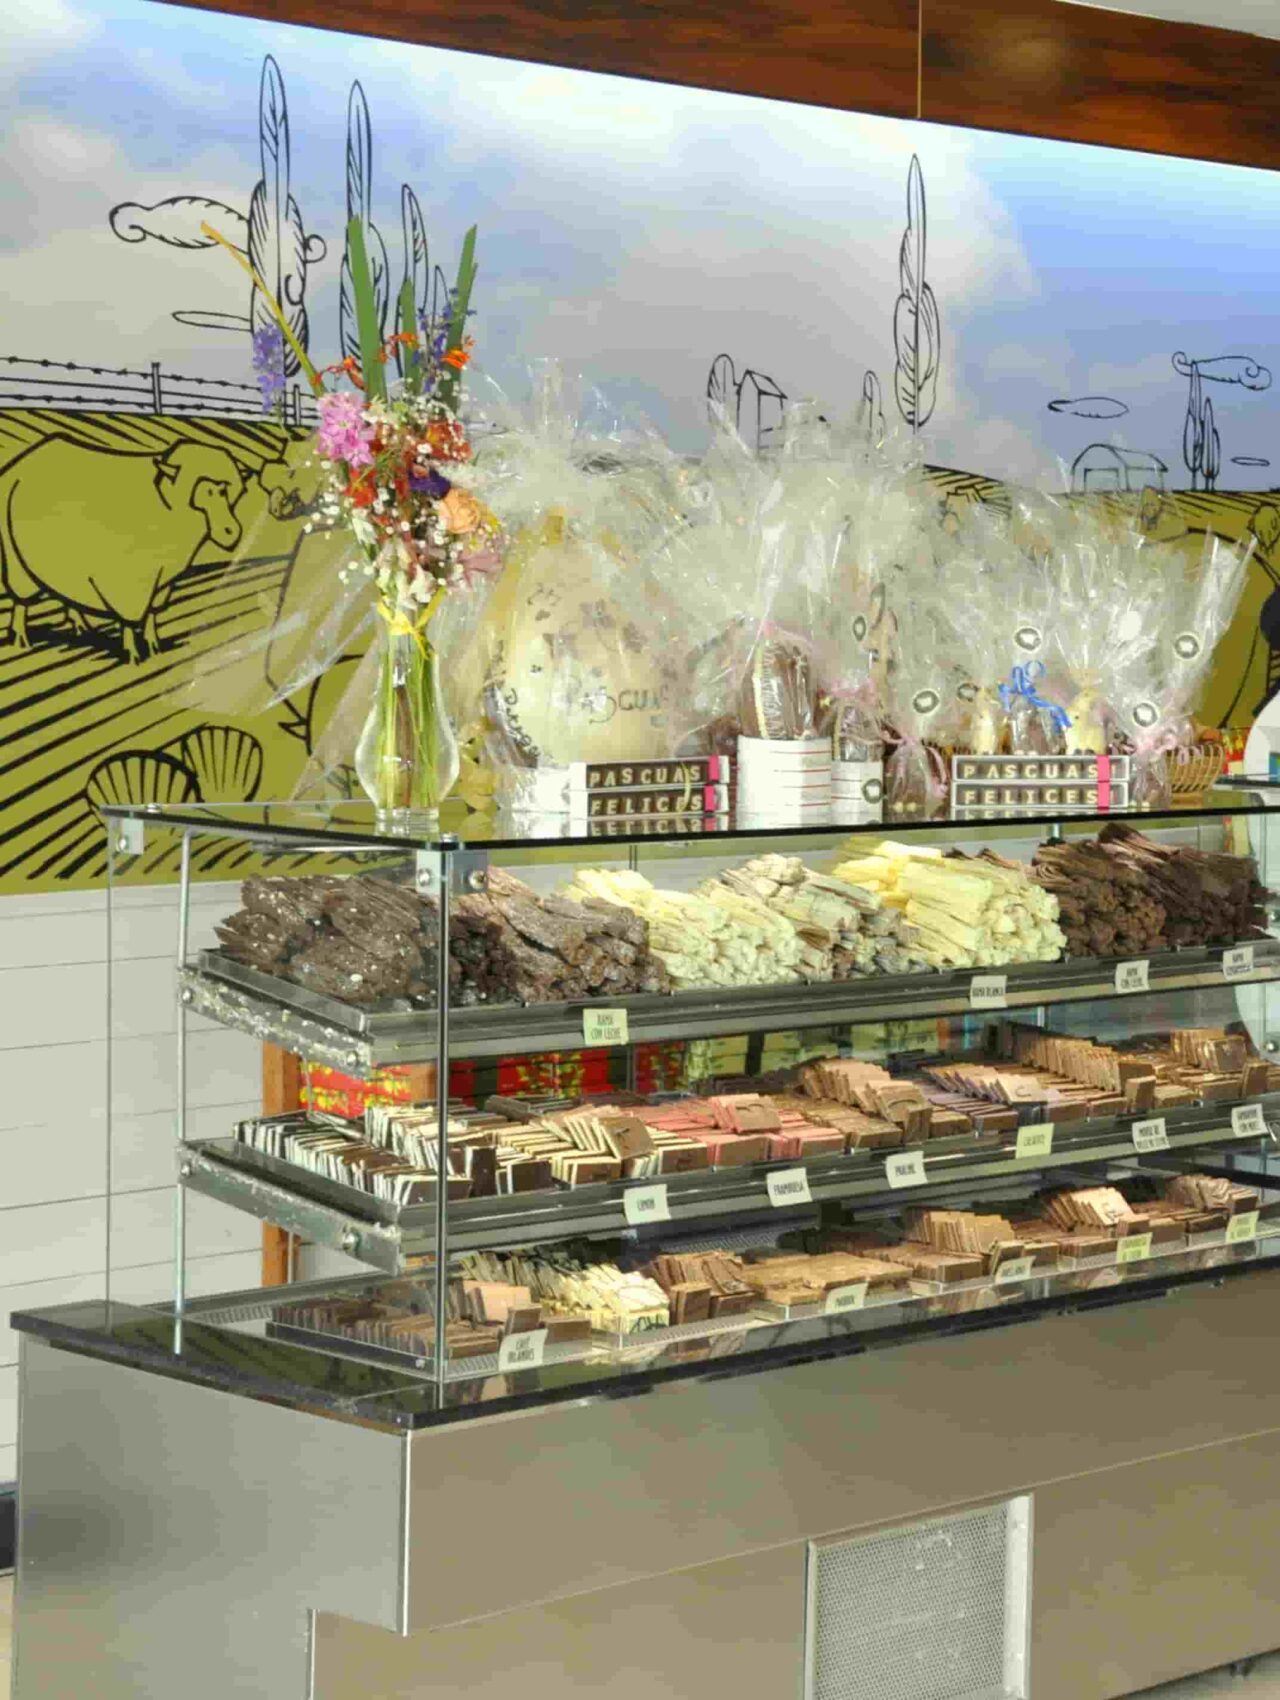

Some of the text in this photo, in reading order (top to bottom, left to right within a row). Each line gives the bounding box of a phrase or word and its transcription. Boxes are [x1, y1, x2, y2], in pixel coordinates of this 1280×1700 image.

[589, 765, 701, 788] PASCUAS
[590, 794, 703, 816] FELICES
[774, 1180, 804, 1196] FRAMBUESA
